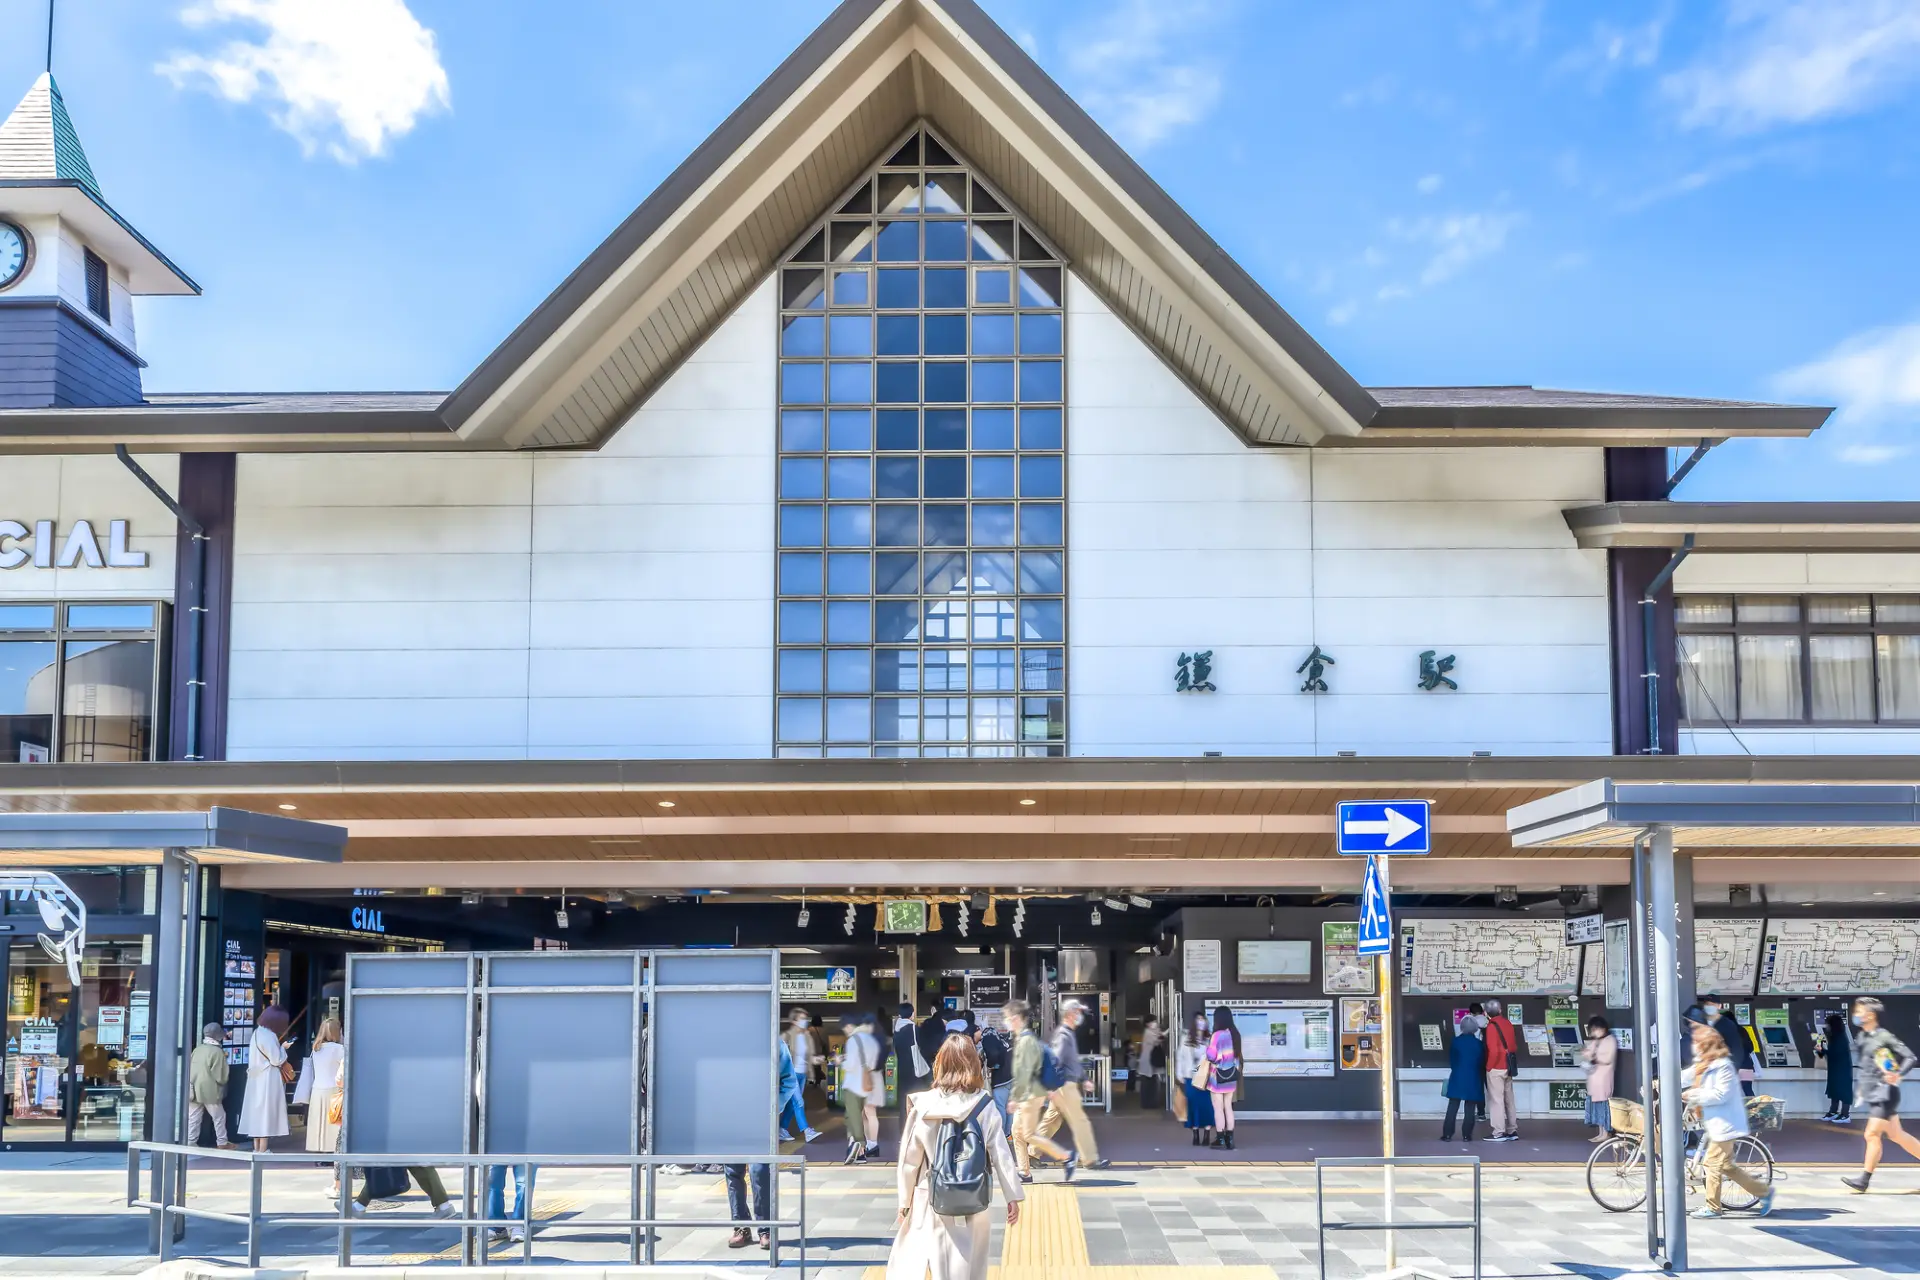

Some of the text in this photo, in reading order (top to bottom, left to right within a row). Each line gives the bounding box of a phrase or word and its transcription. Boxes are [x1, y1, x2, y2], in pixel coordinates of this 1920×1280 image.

[0, 519, 149, 569] CIAL
[1174, 645, 1458, 692] 鎌倉駅
[352, 907, 384, 932] CIAL
[226, 940, 241, 949] CIAL
[780, 981, 813, 989] 住友銀行
[25, 1017, 55, 1026] CIAL
[1557, 1089, 1587, 1099] 江ノ電
